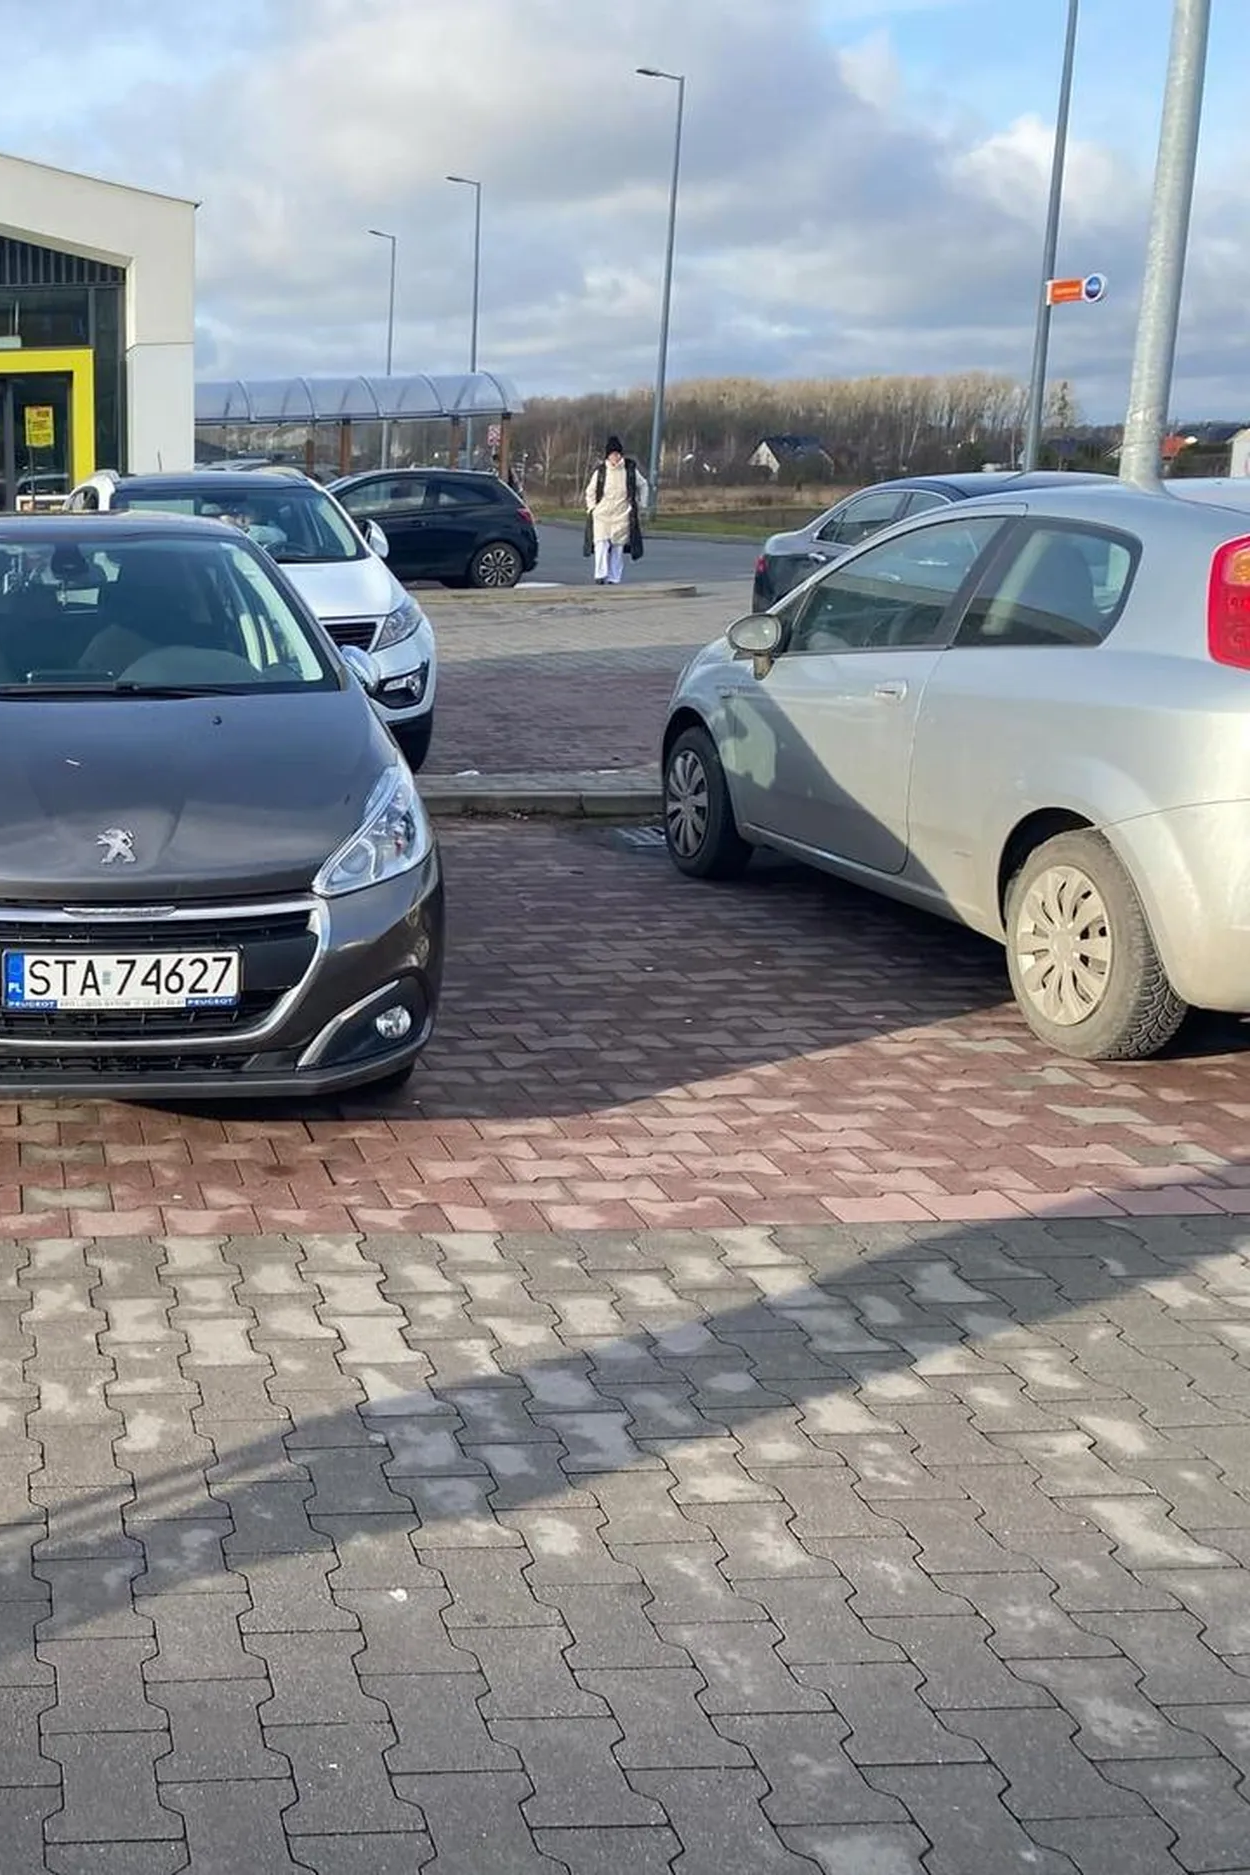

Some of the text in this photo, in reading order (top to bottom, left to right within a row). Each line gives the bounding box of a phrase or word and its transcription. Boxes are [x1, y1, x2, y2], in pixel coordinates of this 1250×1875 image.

[8, 983, 23, 993] PL
[29, 957, 233, 996] STA 74627
